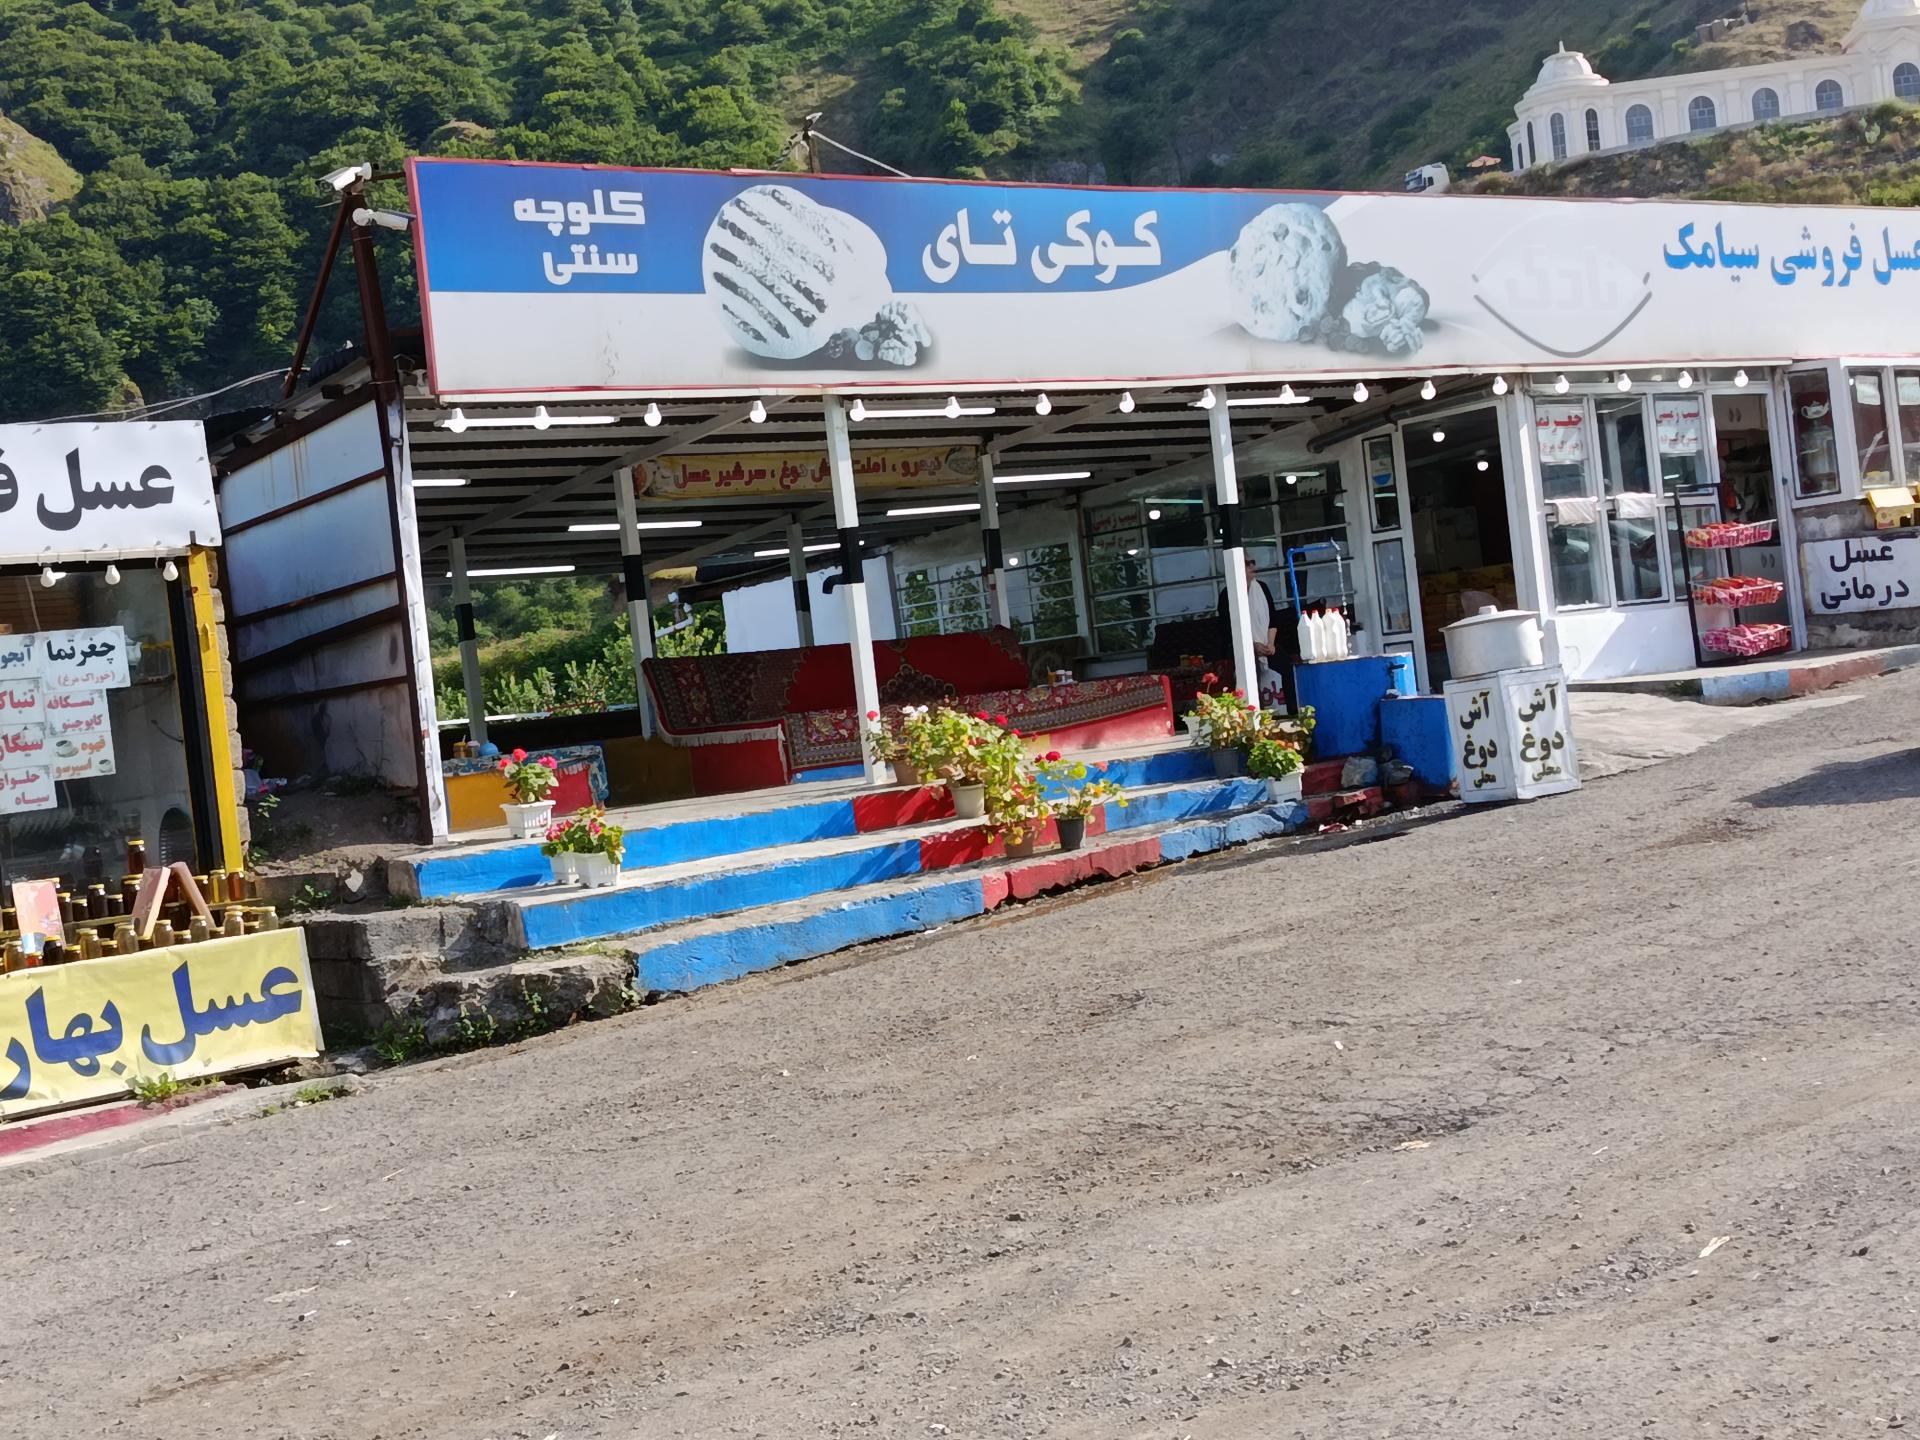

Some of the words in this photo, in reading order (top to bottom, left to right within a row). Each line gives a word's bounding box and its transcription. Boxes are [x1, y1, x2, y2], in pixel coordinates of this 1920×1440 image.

[513, 189, 646, 236] کلوچه
[922, 208, 1017, 284] تای
[1031, 209, 1161, 284] کوکی
[1663, 221, 1760, 283] سیامک
[1770, 222, 1863, 287] فروشی
[542, 244, 639, 285] سنتی
[37, 448, 175, 531] عسل
[673, 463, 711, 489] عسل
[1830, 540, 1894, 572] عسل
[1821, 577, 1909, 609] درمانی
[0, 644, 32, 669] آبجو
[47, 696, 95, 710] نسکافه
[1460, 691, 1490, 729] آش
[1518, 682, 1559, 722] آش
[80, 736, 106, 755] قهوه
[1463, 735, 1498, 769] دوغ
[1520, 727, 1564, 762] دوغ
[1474, 767, 1496, 788] محلی
[1532, 761, 1561, 782] محلی
[15, 791, 50, 807] سیاه
[140, 961, 302, 1066] عسل
